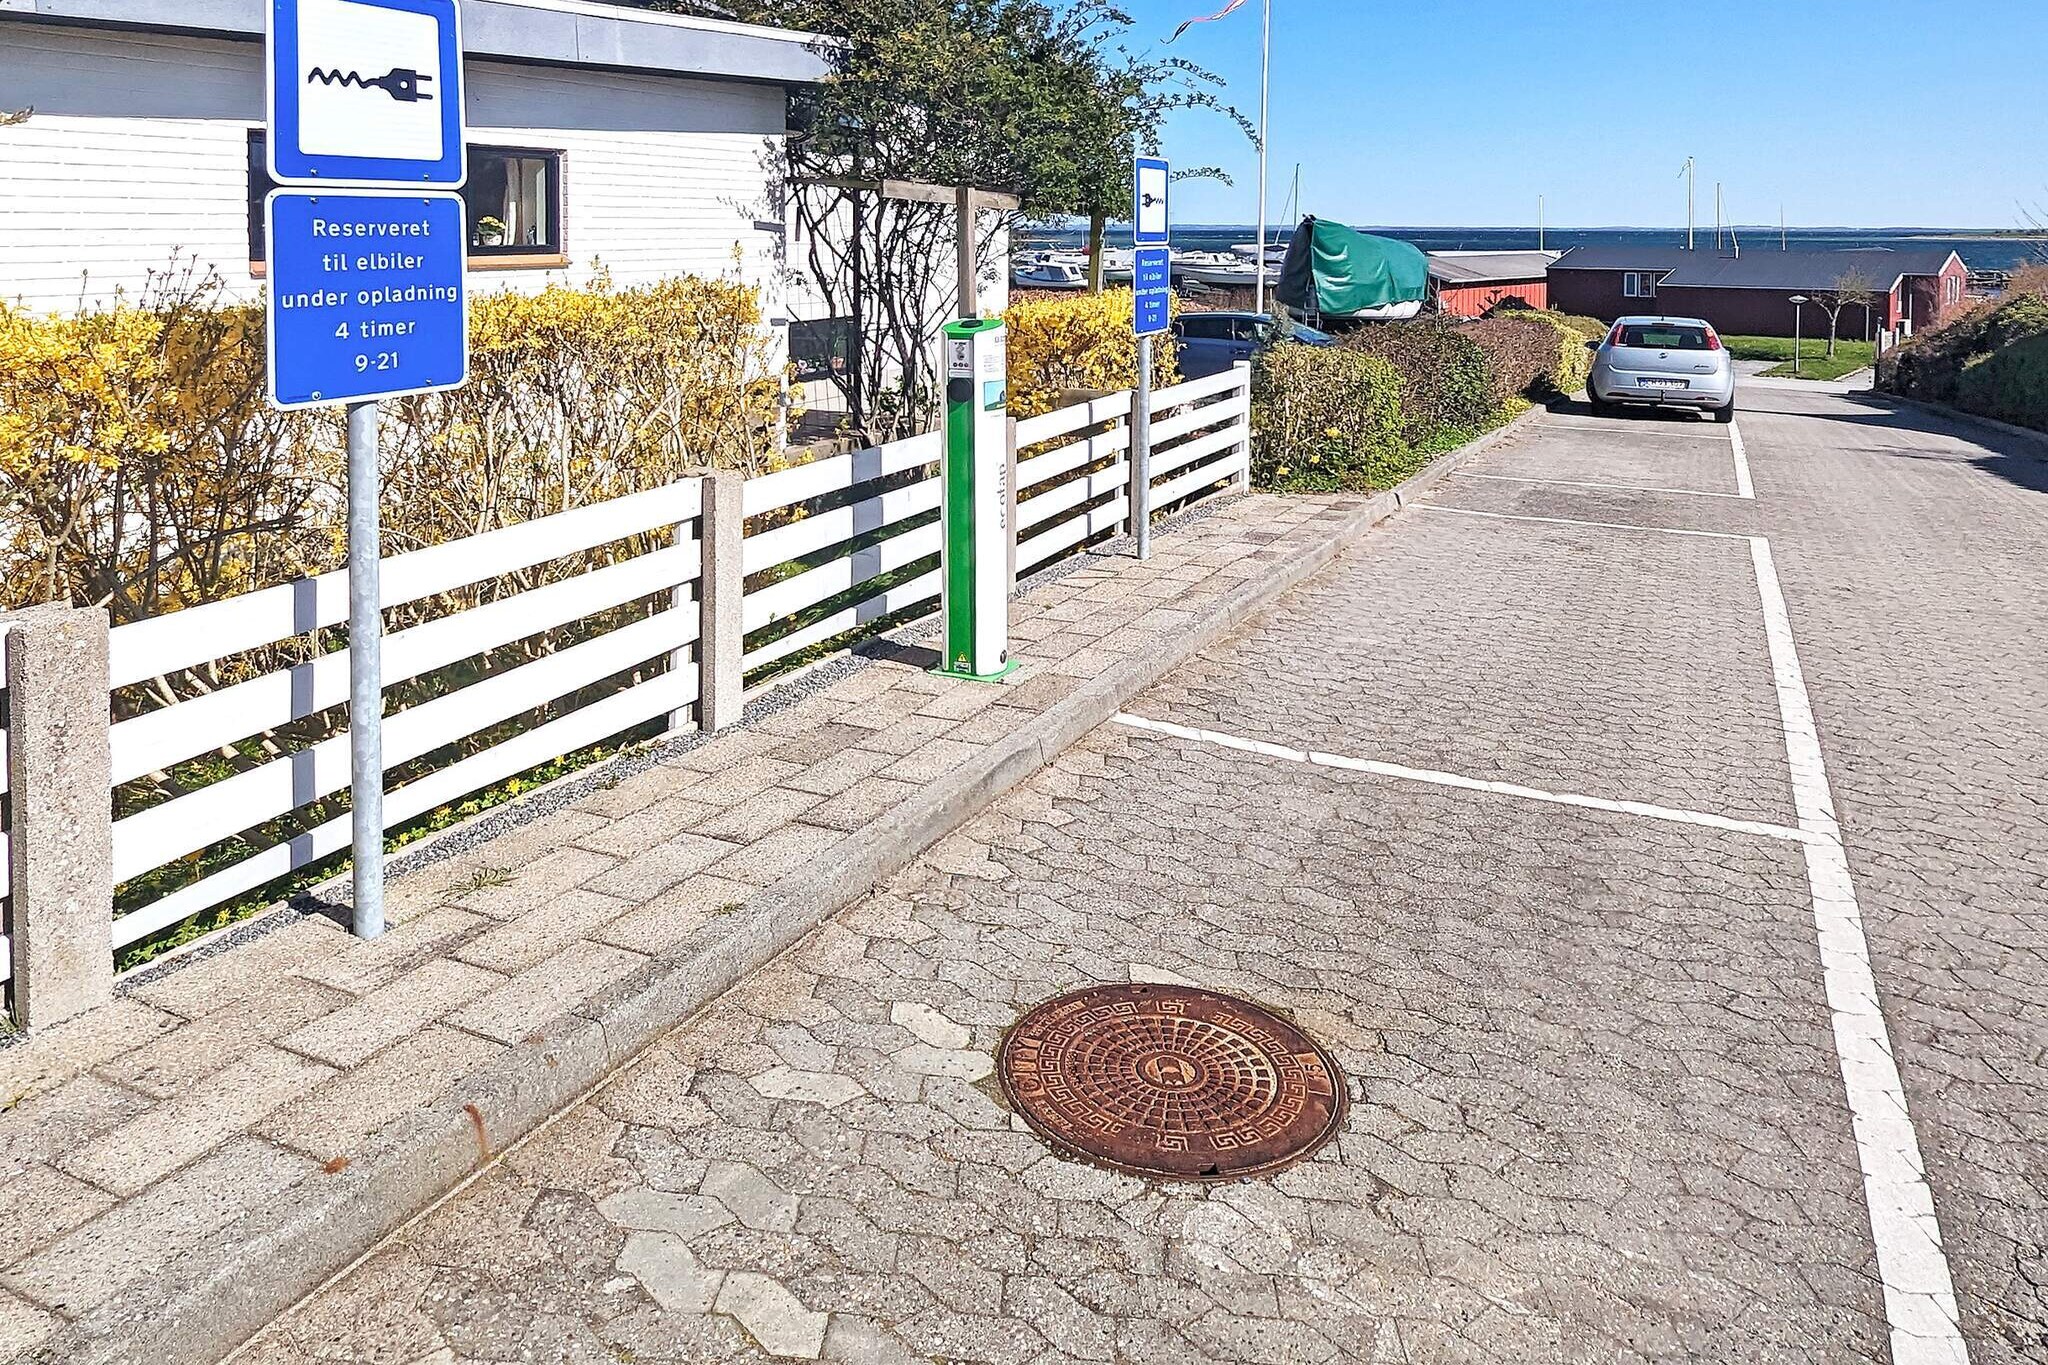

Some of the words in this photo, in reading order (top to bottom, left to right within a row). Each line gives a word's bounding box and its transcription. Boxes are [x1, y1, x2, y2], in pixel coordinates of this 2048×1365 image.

[313, 218, 430, 237] Reserveret
[322, 254, 348, 271] til
[356, 253, 424, 271] elbiler
[281, 289, 348, 308] under
[357, 284, 457, 307] opladning
[334, 322, 350, 340] 4
[360, 320, 416, 339] timer
[354, 351, 400, 373] 9-21
